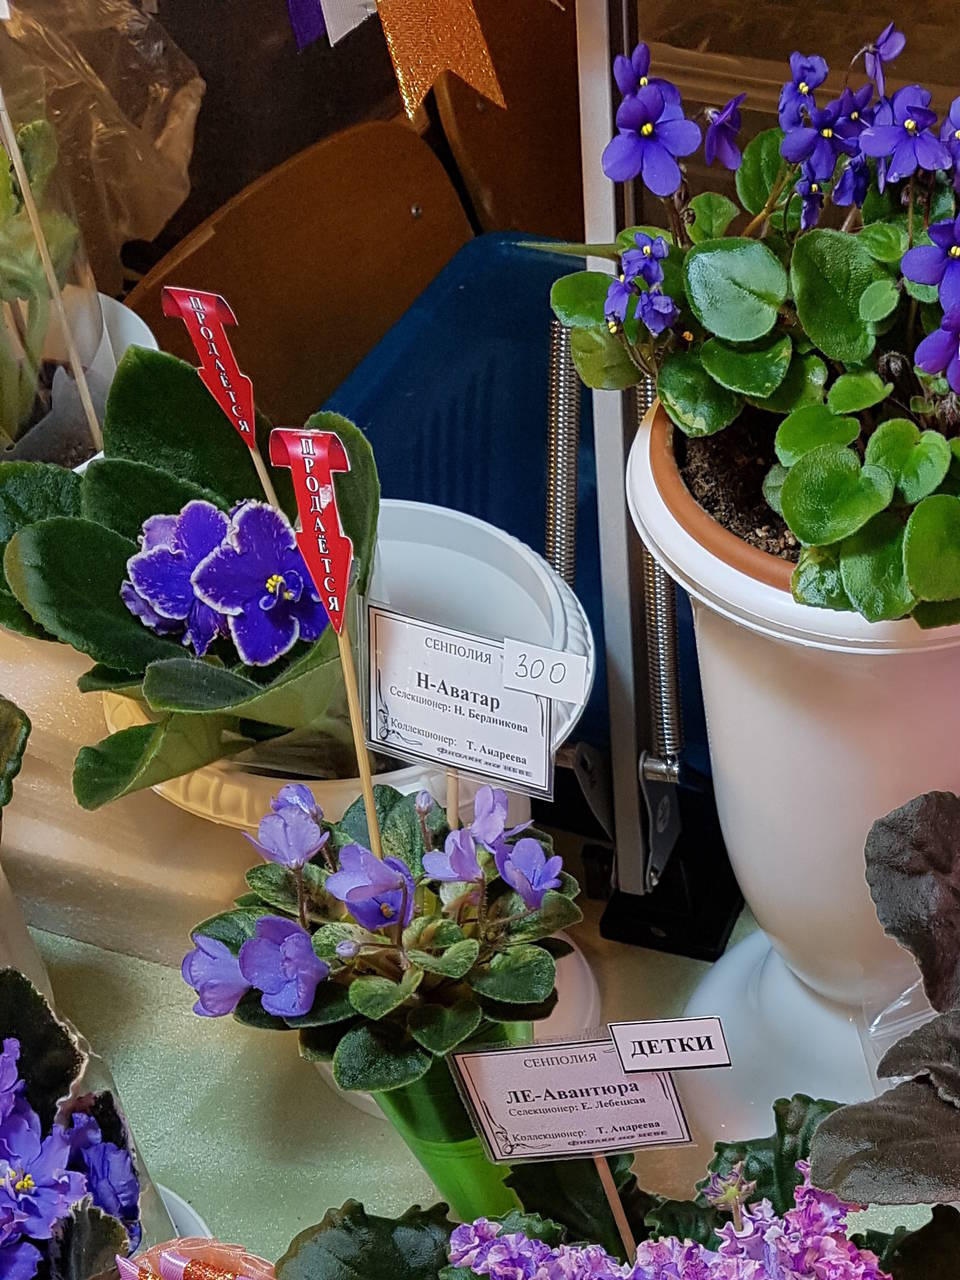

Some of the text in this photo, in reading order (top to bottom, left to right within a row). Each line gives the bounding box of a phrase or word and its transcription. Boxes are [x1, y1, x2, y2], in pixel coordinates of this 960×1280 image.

[188, 295, 250, 433] ПРОДАЁТСЯ
[299, 437, 341, 613] ПРОДАЁТСЯ
[424, 636, 492, 665] СЕНПОЛИЯ
[514, 653, 567, 684] 300
[389, 685, 453, 713] Селекционер:
[453, 704, 465, 717] Н.
[416, 671, 501, 710] Н-Аватар
[390, 717, 528, 765] Коллекционер: Т. Андреева
[523, 1052, 598, 1070] СЕНПОЛИЯ
[630, 1034, 715, 1059] ДЕТКИ
[506, 1080, 640, 1105] ЛЕ-Авантюра
[508, 1102, 580, 1118] Селекционер:
[512, 1120, 661, 1143] Коллекционер: Т. Андреева
